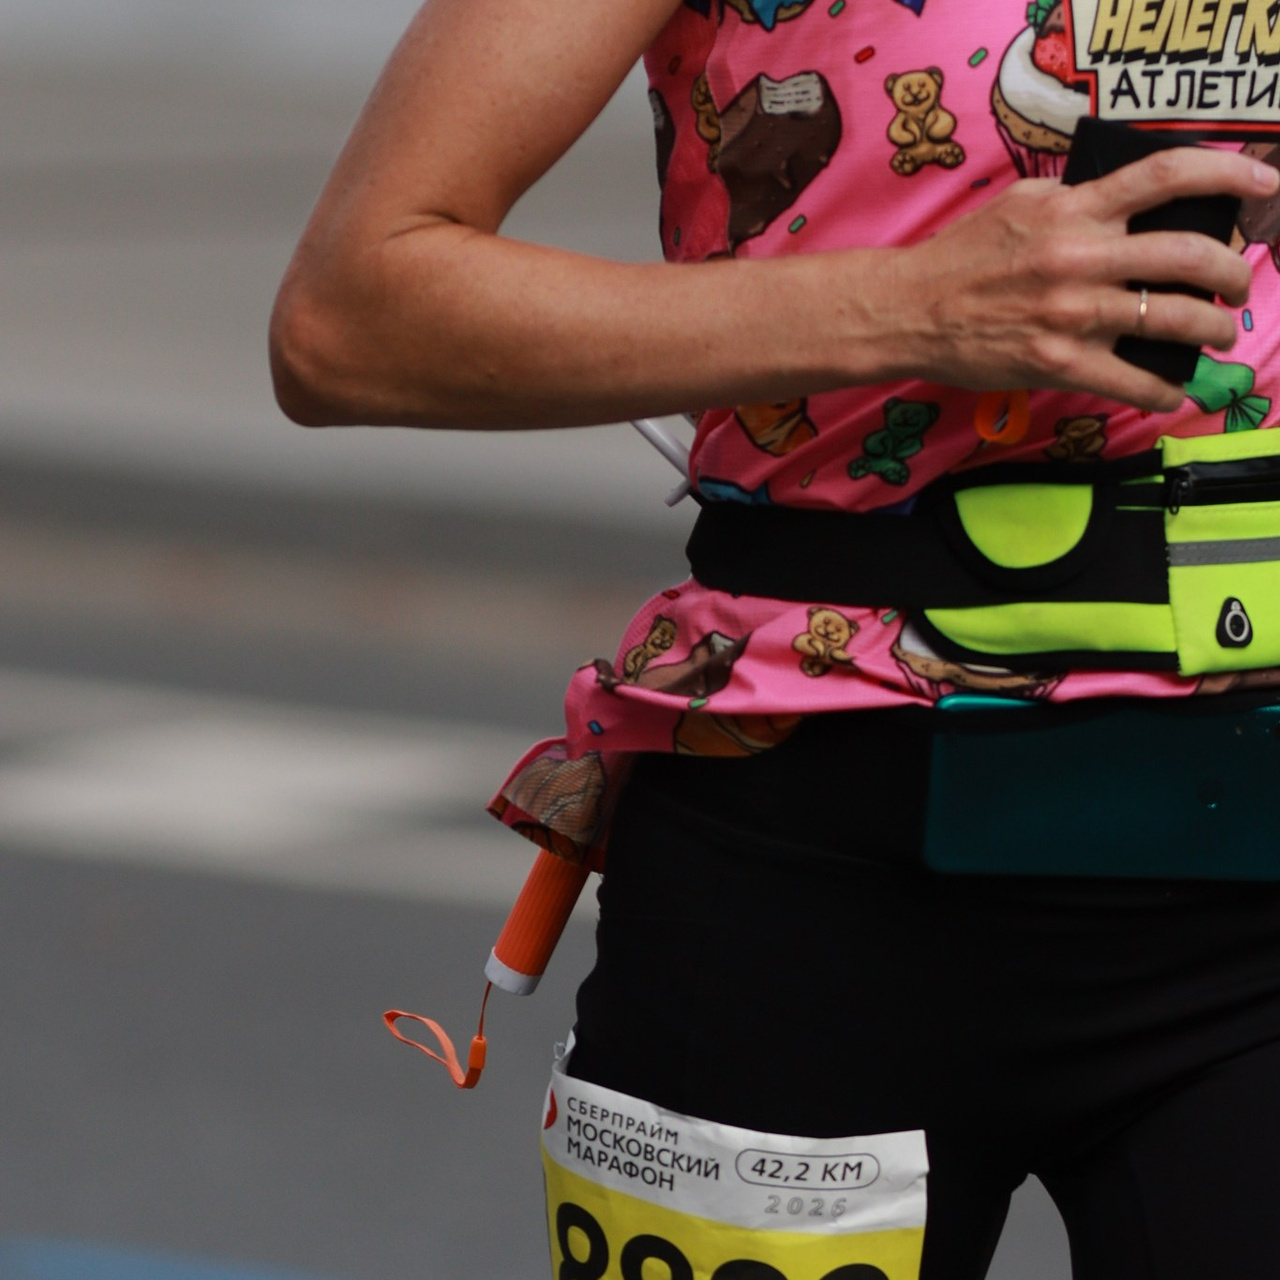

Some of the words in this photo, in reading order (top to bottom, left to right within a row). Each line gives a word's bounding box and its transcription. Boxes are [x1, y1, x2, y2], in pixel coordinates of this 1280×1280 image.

[566, 1096, 679, 1146] СБЕРПРАЙМ
[566, 1115, 720, 1181] МОСКОВСКИЙ
[566, 1137, 675, 1192] МАРАФОН
[751, 1158, 810, 1183] 42,2
[821, 1161, 863, 1183] КМ
[764, 1194, 848, 1218] 2026
